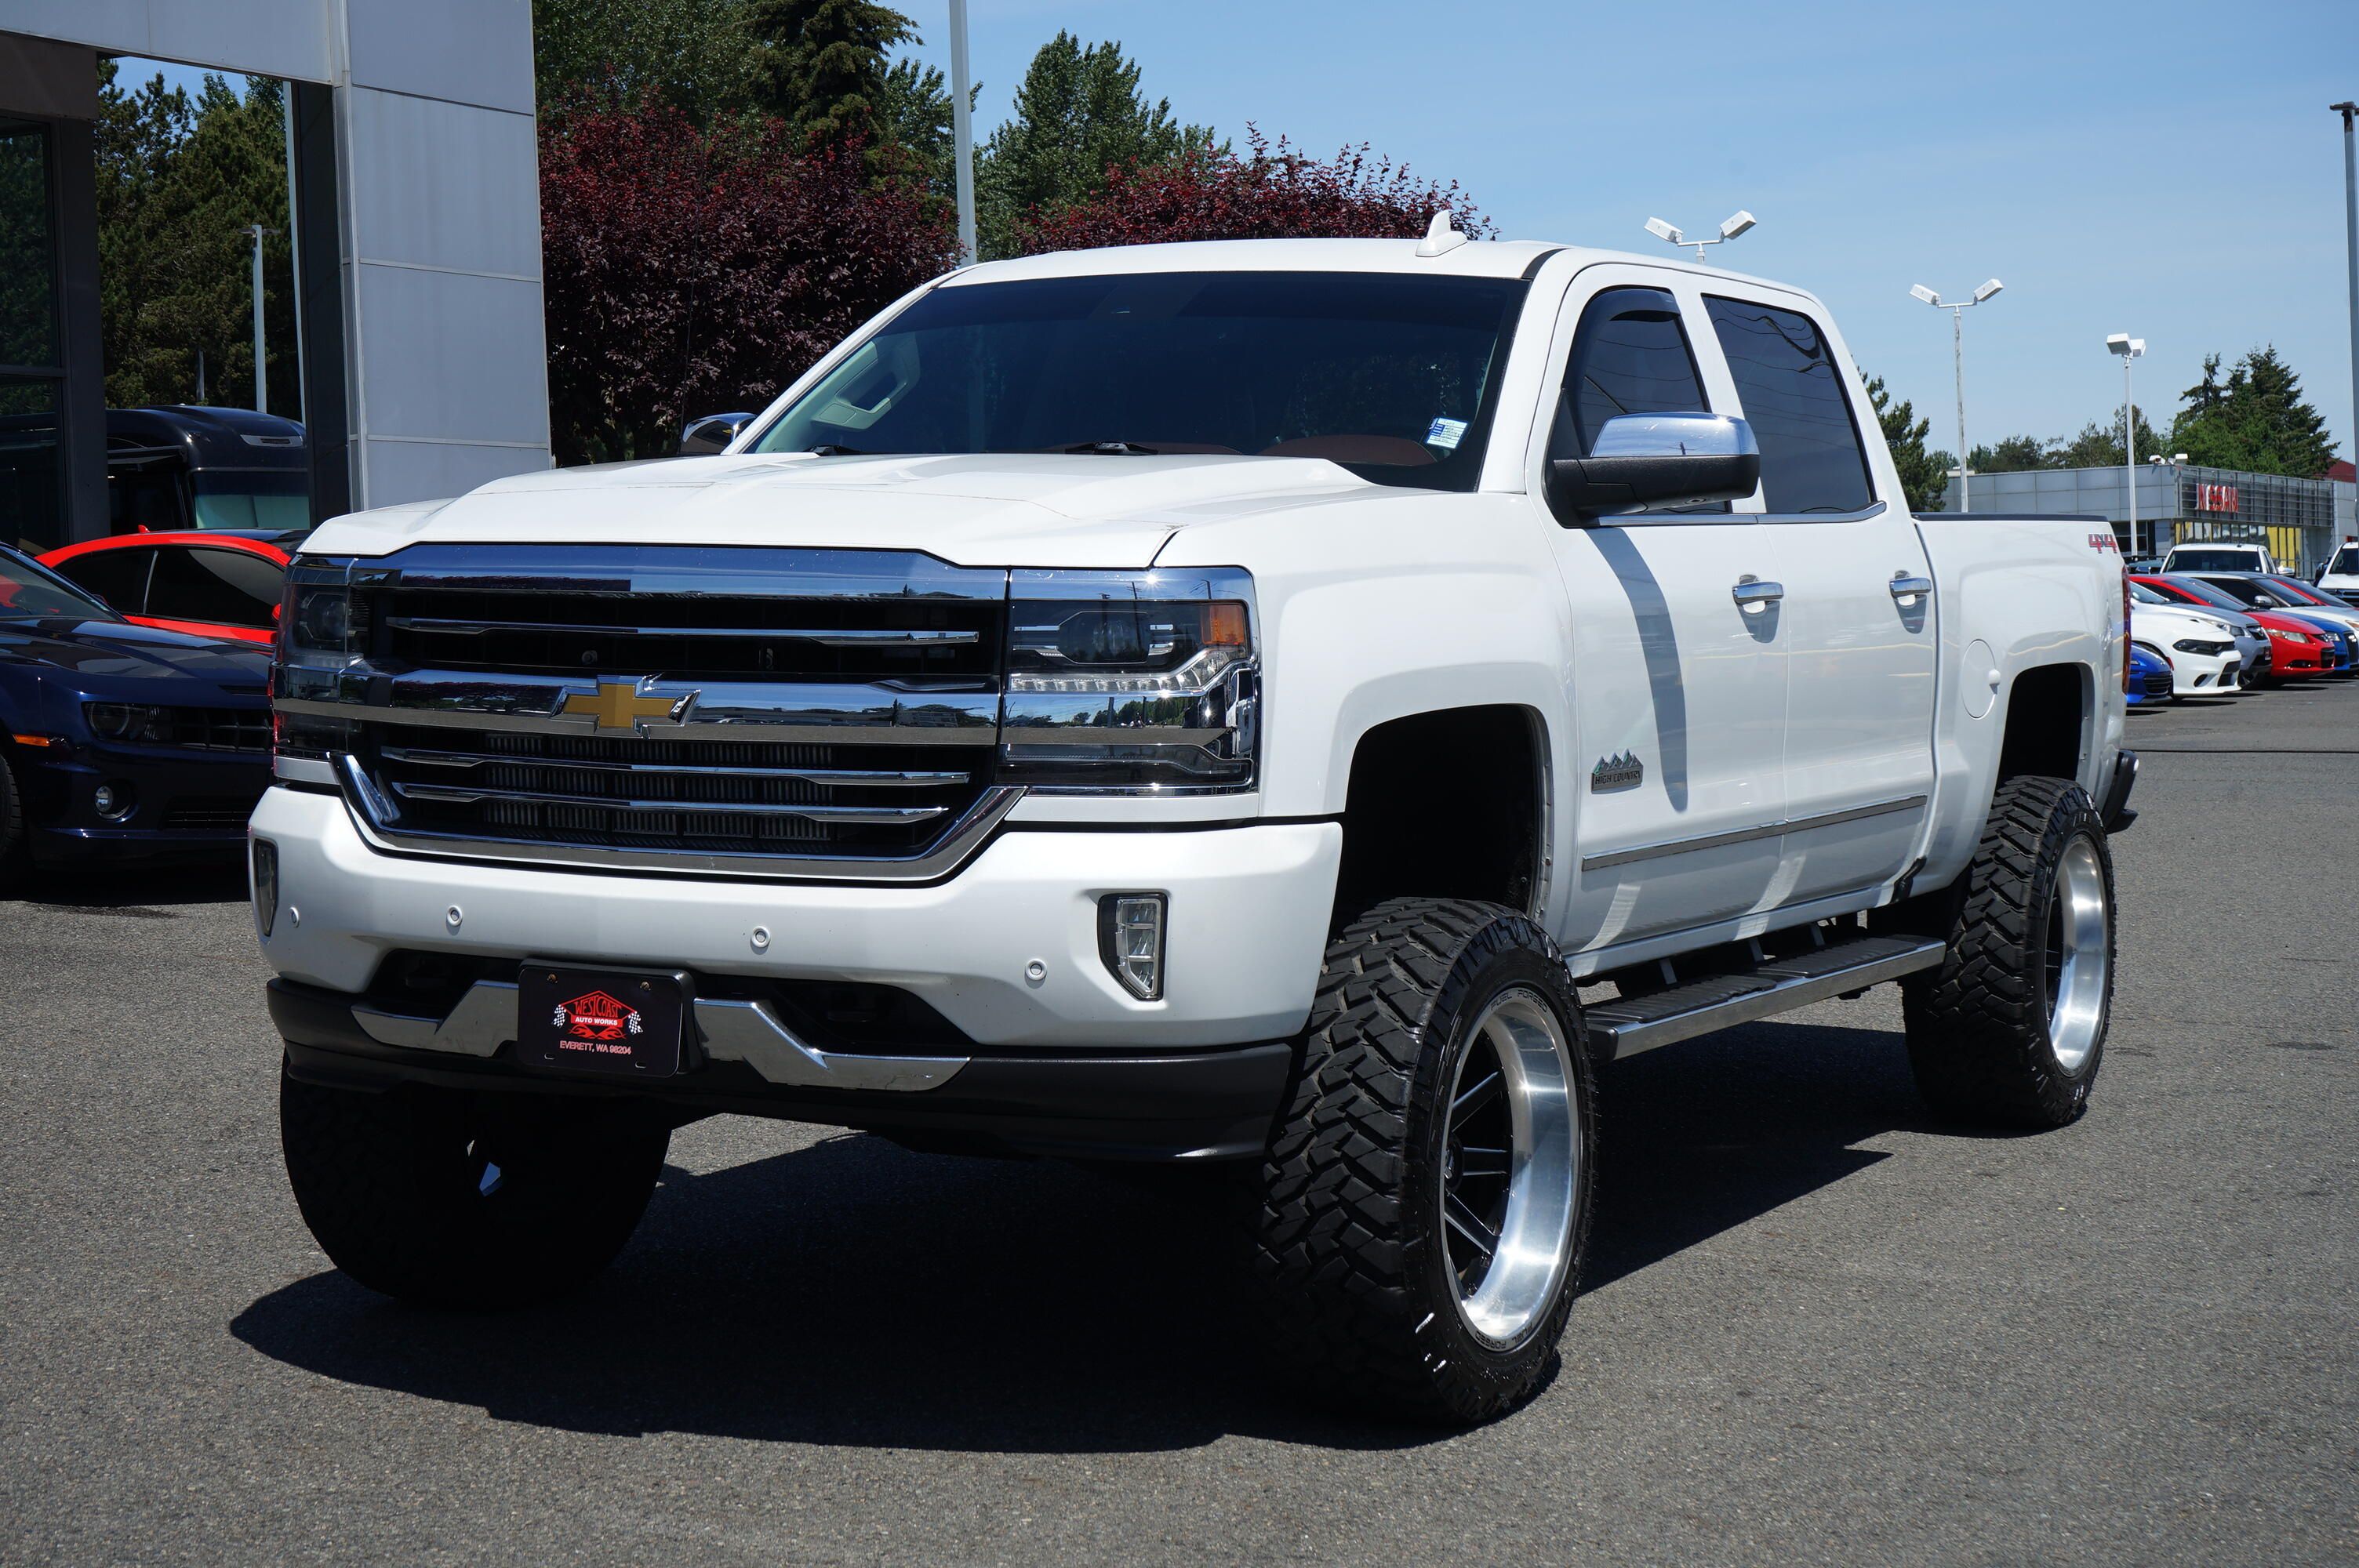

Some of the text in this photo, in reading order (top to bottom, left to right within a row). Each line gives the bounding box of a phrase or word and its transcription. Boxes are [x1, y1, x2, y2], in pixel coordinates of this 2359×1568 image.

[2196, 483, 2239, 514] NISSAN
[1595, 770, 1641, 785] HIGH COUNTRY
[1491, 992, 1513, 1011] FUEL
[559, 1040, 594, 1052] EVERETT,
[595, 1044, 609, 1053] WA
